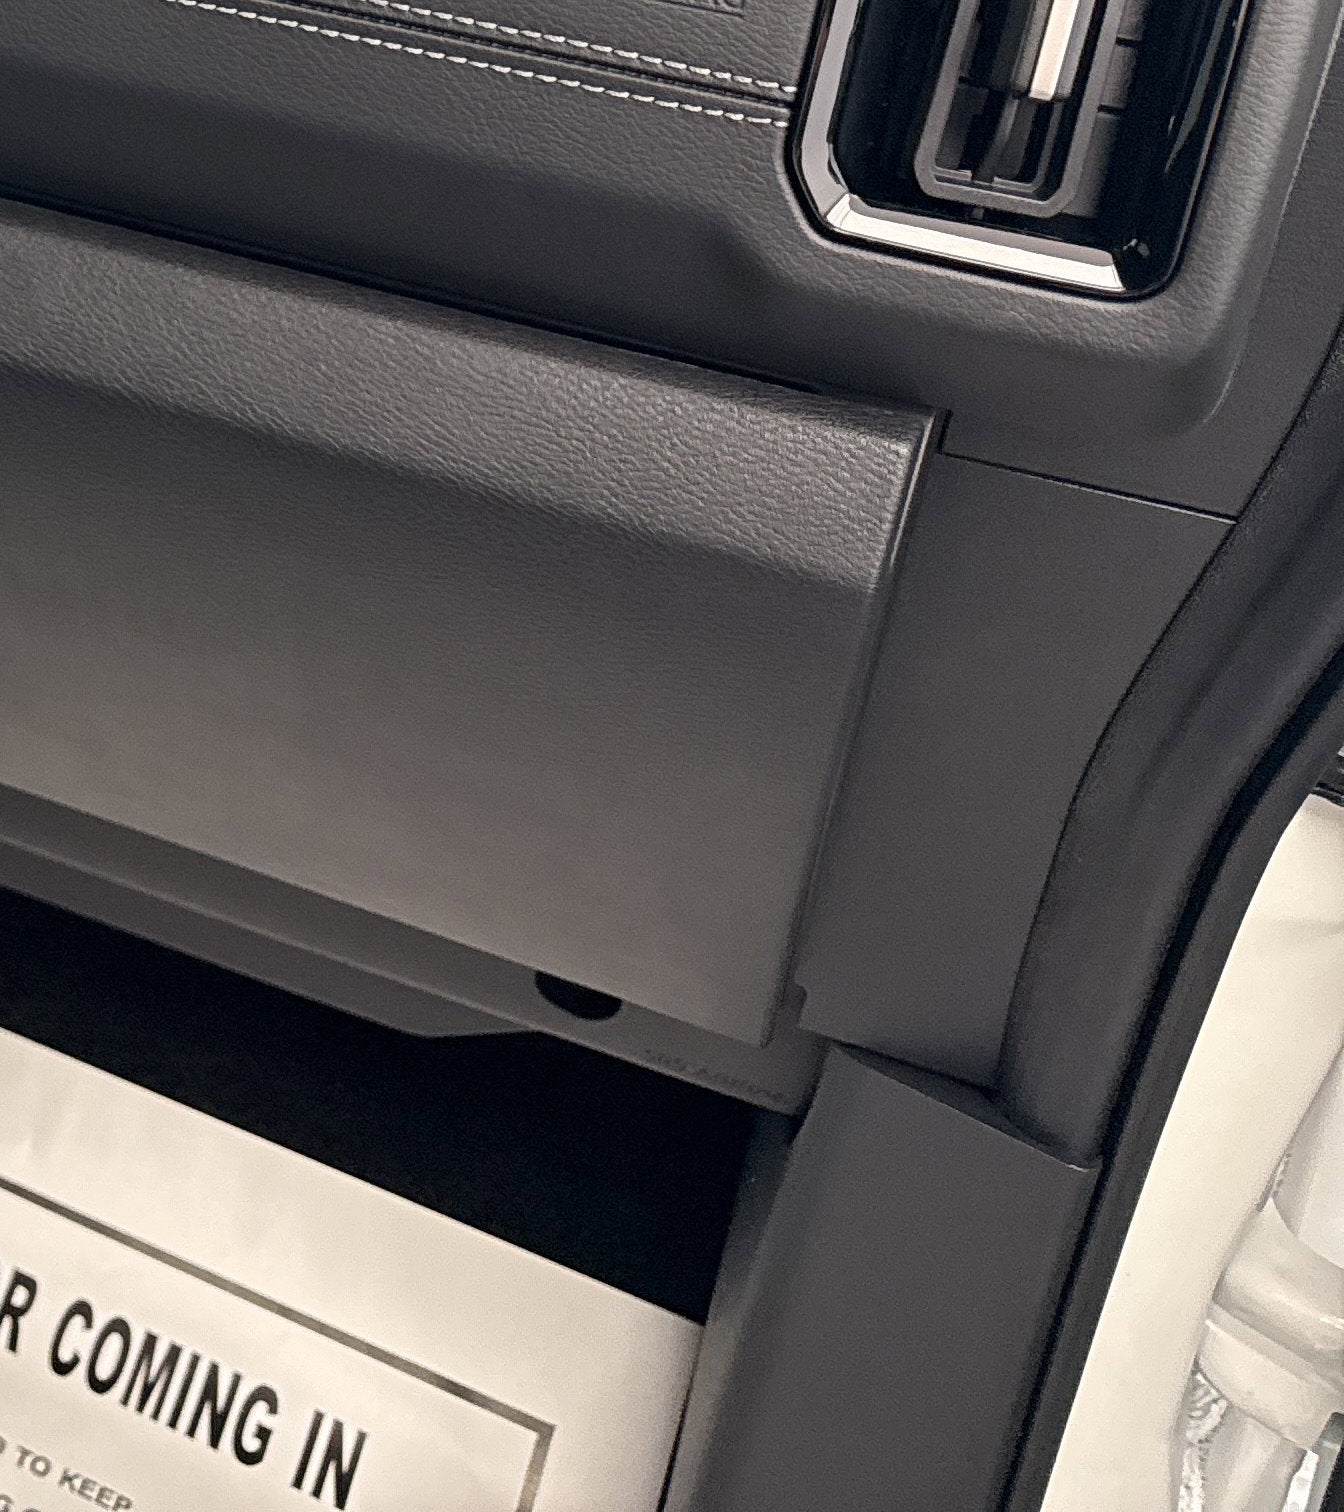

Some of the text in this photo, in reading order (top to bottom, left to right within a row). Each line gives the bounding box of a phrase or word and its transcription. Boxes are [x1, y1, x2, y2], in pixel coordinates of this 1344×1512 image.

[49, 1297, 278, 1466] COMING
[290, 1409, 368, 1511] IN
[15, 1446, 52, 1478] TO
[58, 1468, 133, 1512] KEEP
